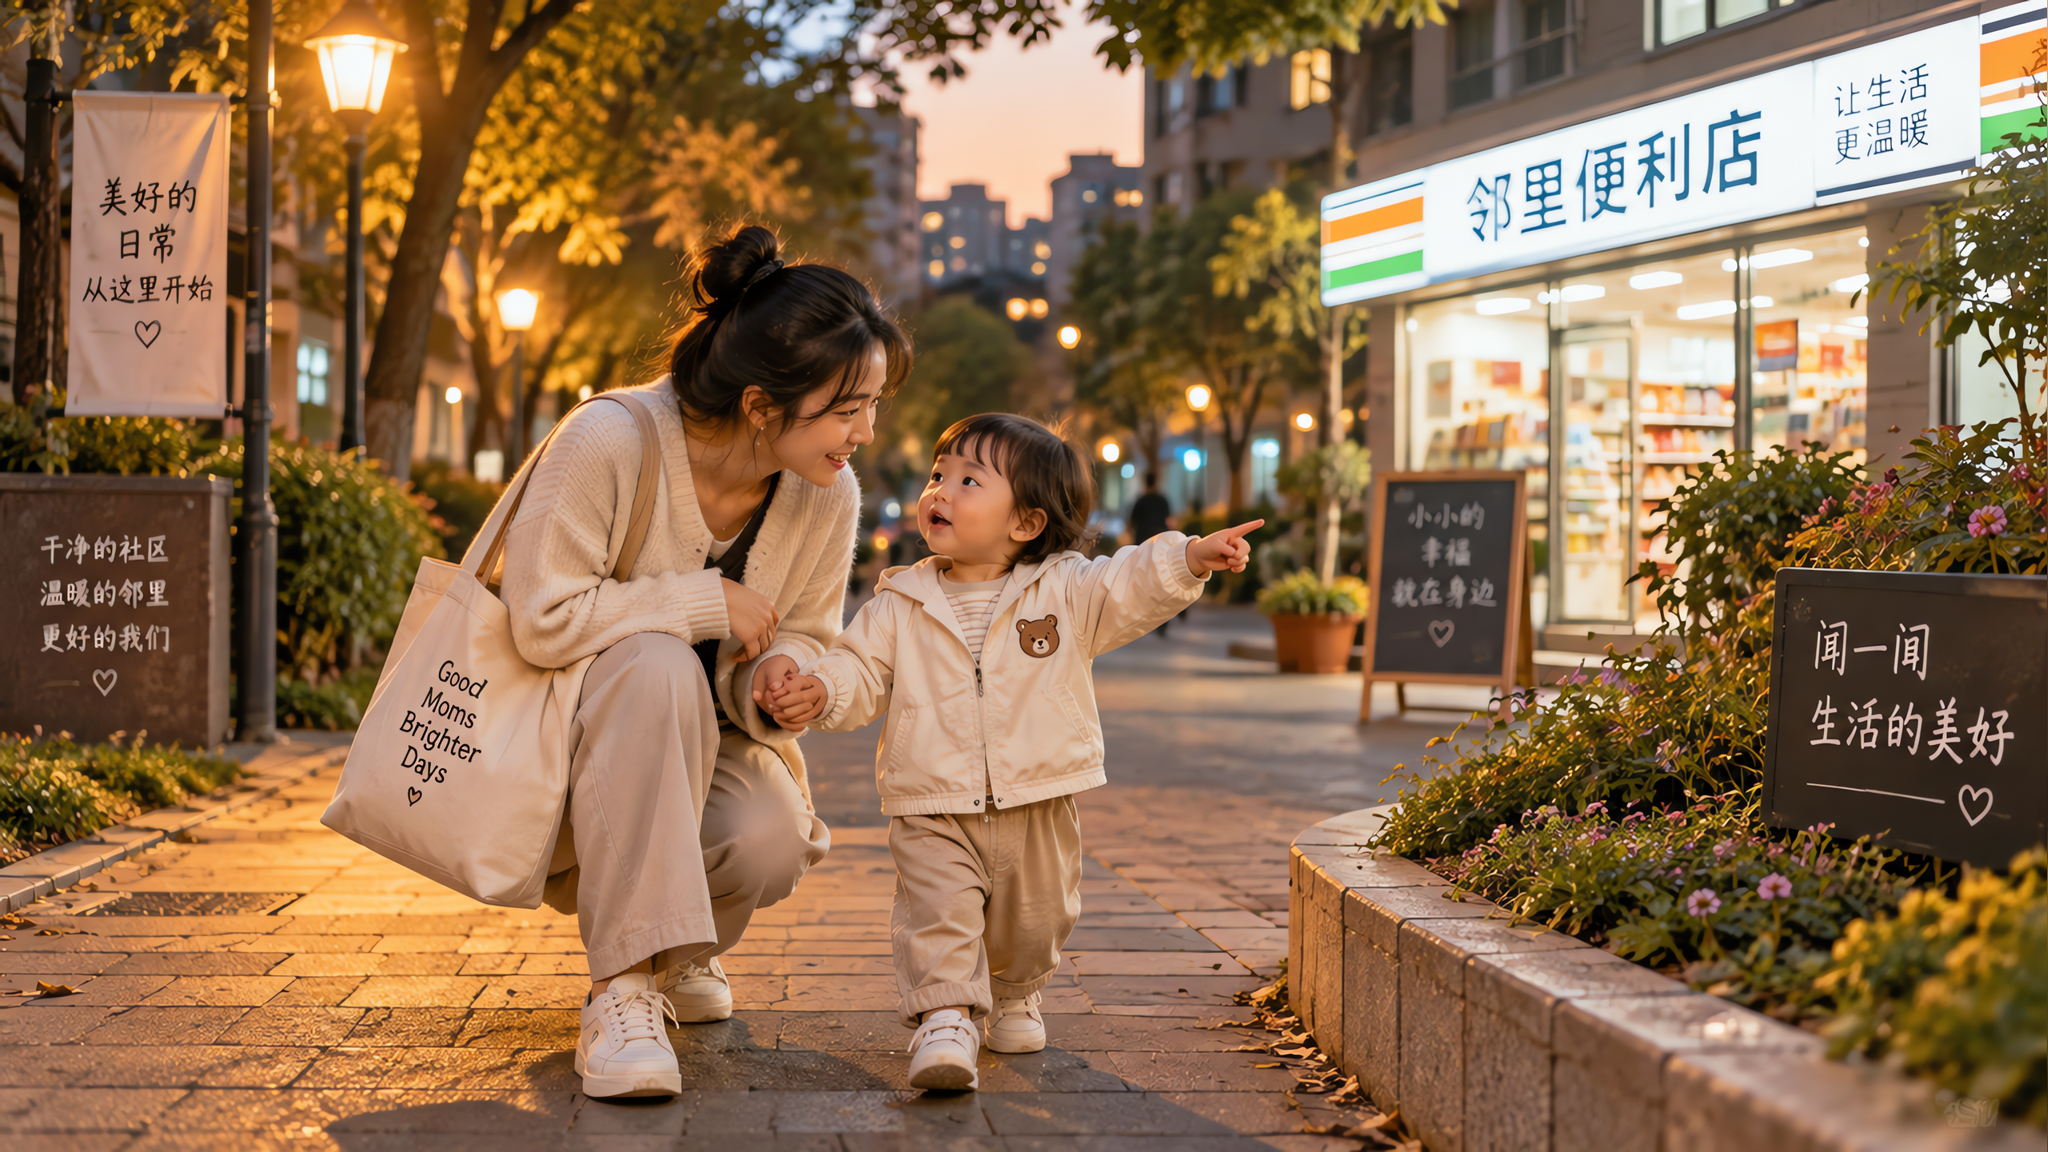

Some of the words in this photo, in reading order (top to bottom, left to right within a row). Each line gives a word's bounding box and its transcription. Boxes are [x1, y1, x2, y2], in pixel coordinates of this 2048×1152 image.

[1834, 63, 1929, 118] 让生活
[1835, 109, 1929, 165] 更温暖
[1466, 109, 1762, 242] 邻里便利店
[99, 176, 197, 216] 美好的
[120, 223, 176, 264] 日常
[82, 274, 213, 304] 从这里开始
[1407, 500, 1485, 531] 小小的
[40, 533, 169, 565] 干净的社区
[1420, 535, 1471, 569] 幸福
[40, 578, 169, 609] 温暖的邻里
[1390, 574, 1498, 609] 就在身边
[40, 623, 170, 653] 更好的我们
[1814, 619, 1930, 681] 闻一闻
[437, 660, 488, 699] Good
[420, 686, 477, 729] Moms
[399, 710, 482, 763] Brighter
[1809, 694, 2015, 766] 生活的美好
[400, 745, 448, 784] Days
